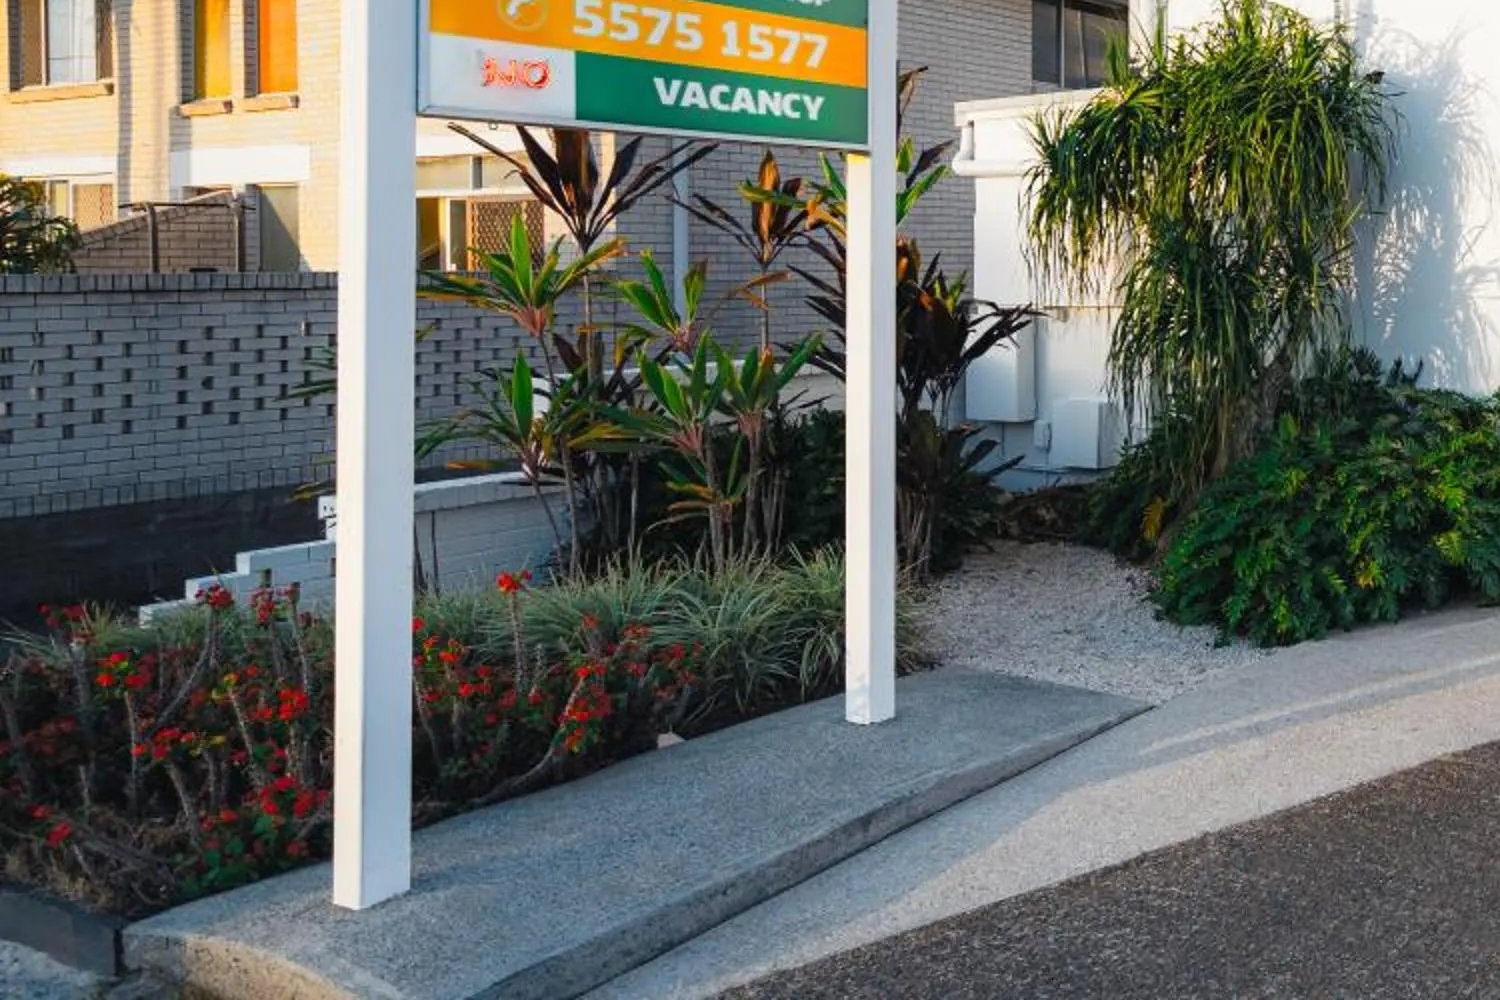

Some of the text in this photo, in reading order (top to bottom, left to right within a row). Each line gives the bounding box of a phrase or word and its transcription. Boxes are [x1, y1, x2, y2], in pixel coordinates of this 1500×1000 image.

[720, 20, 829, 69] 1577
[483, 56, 826, 121] NO VACANCY
